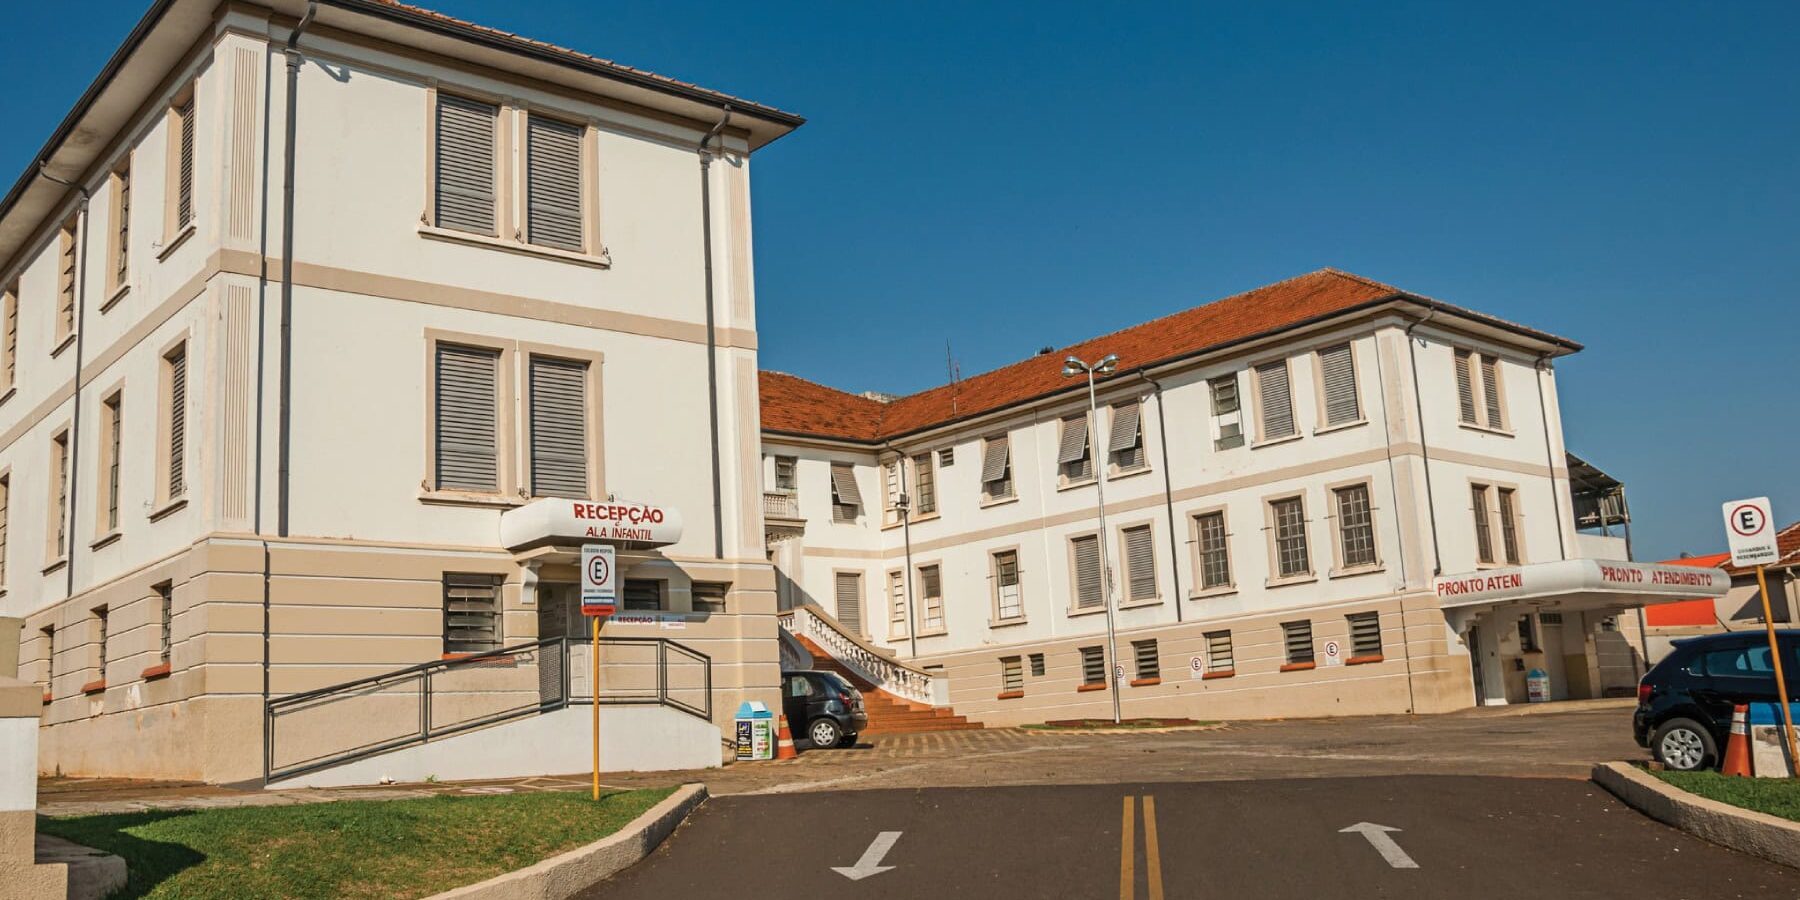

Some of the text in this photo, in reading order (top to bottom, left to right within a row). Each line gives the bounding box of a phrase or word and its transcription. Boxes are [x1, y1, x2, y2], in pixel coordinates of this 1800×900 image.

[1740, 510, 1755, 530] E
[585, 526, 653, 541] ALA INFANTIL
[594, 561, 602, 580] E
[1600, 566, 1713, 587] PRONTO ATENDIMENTO
[1437, 578, 1484, 597] PRONTO
[1329, 645, 1335, 654] E
[1194, 660, 1200, 668] E
